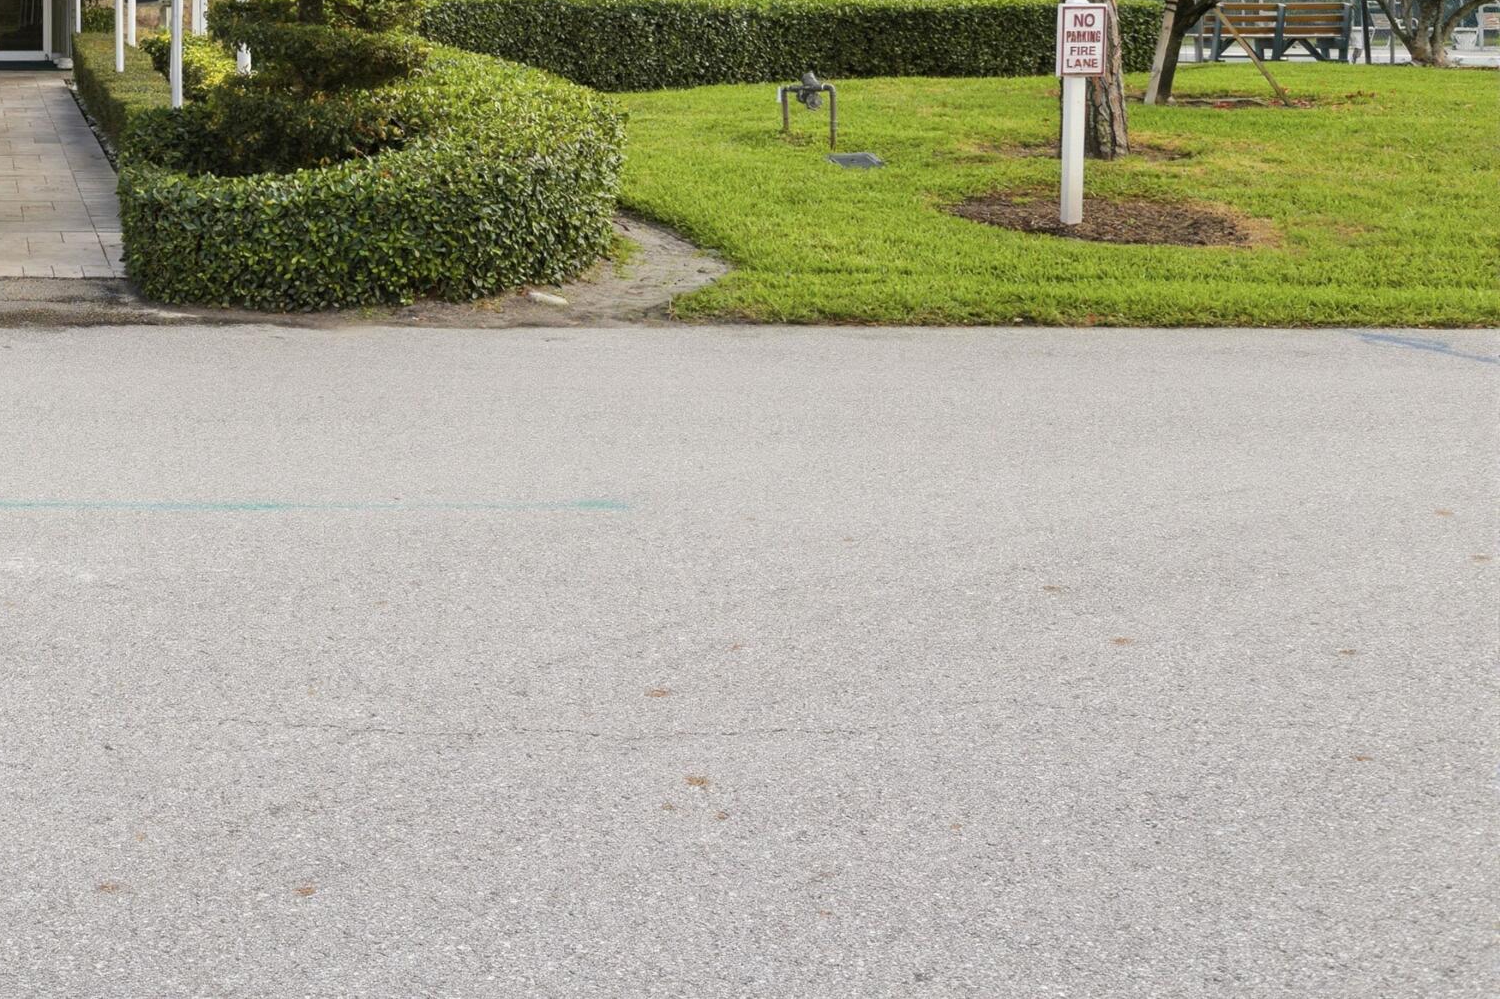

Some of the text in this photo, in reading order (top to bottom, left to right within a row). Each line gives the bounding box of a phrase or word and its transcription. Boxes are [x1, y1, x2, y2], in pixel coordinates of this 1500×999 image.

[1073, 13, 1095, 27] NO
[1066, 30, 1101, 43] PARKING
[1070, 46, 1096, 56] FIRE
[1066, 58, 1098, 68] LANE
